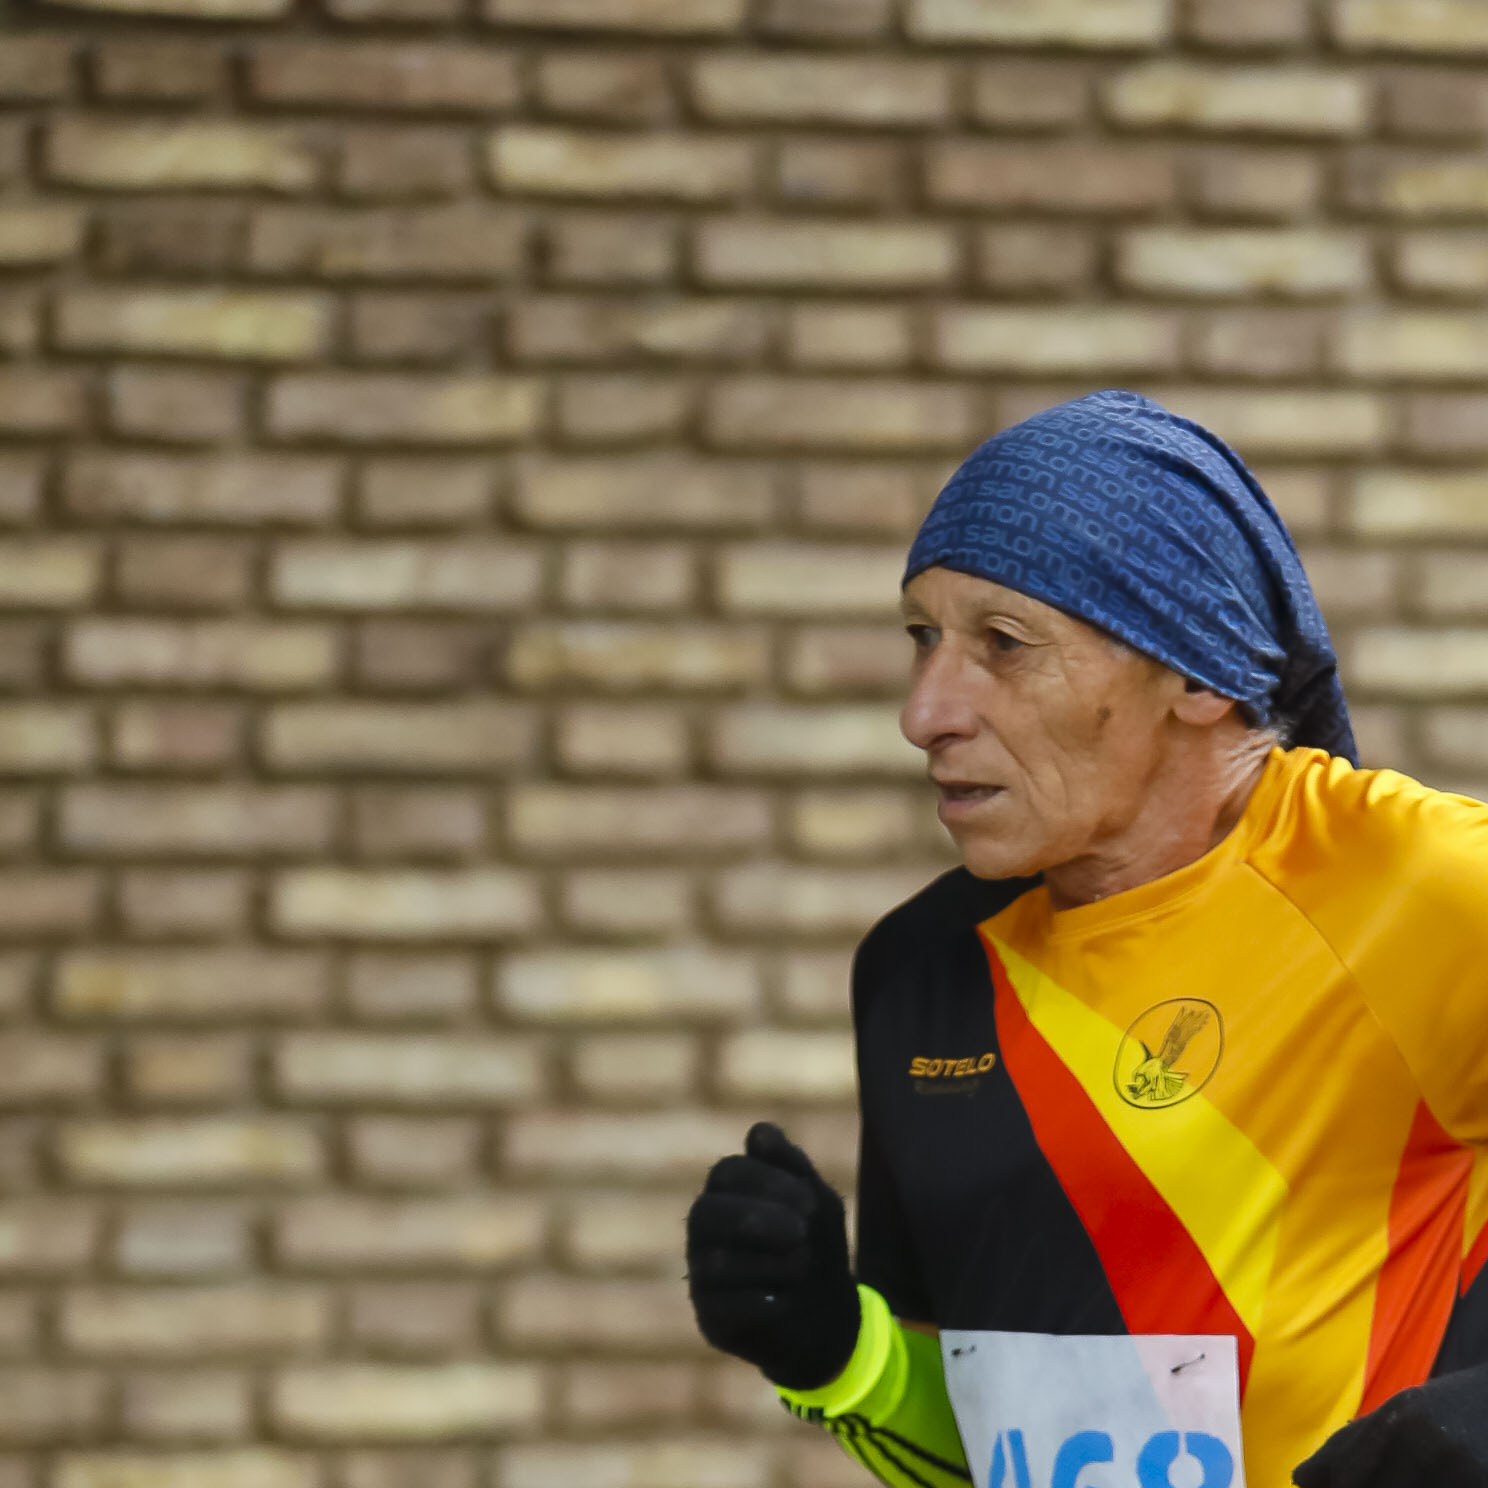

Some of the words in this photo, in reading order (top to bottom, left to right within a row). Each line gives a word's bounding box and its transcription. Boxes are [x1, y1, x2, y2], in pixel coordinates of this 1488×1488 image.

[998, 441, 1142, 513] salomon
[1078, 448, 1211, 541] salomon
[974, 480, 1123, 557] salomon
[1057, 481, 1199, 577] salomon
[962, 523, 1105, 599] salomon
[1040, 520, 1185, 624] salomon
[908, 1052, 997, 1080] SOTELO
